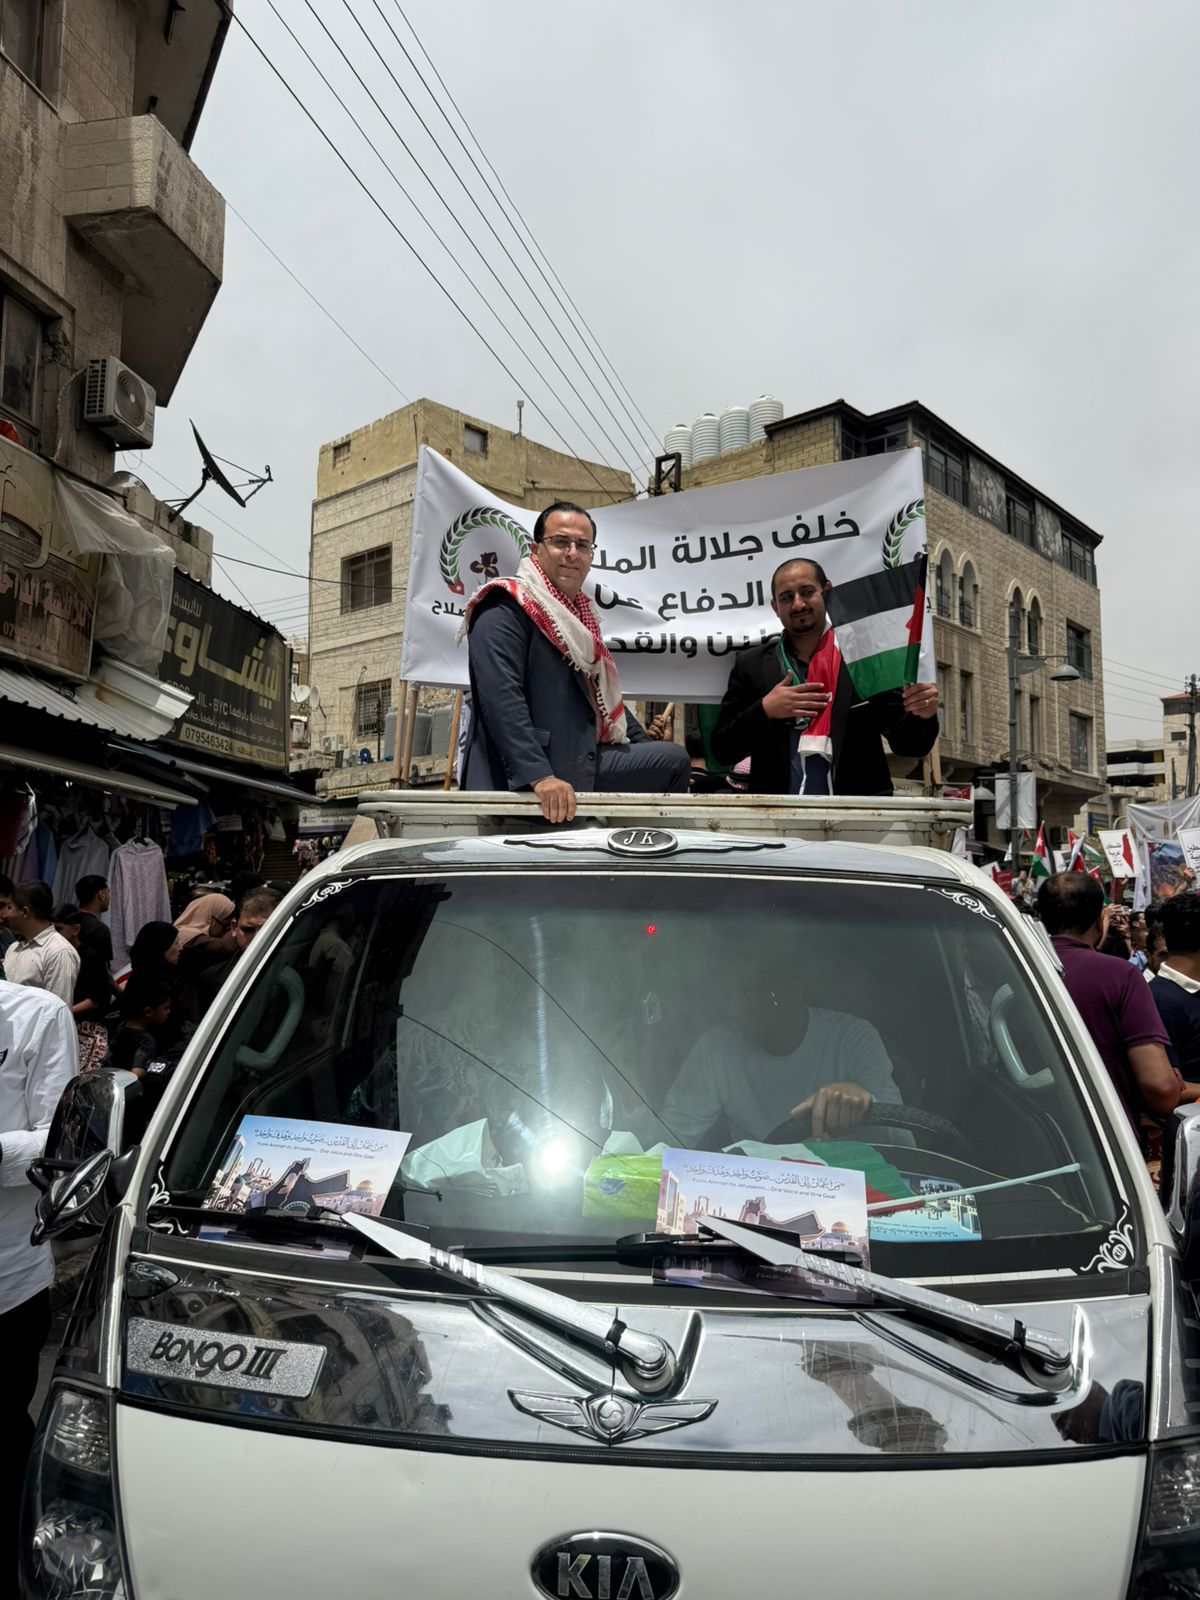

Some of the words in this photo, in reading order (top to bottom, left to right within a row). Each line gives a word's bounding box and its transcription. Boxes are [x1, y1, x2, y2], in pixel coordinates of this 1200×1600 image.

[772, 511, 860, 549] خلف
[672, 532, 763, 564] جلالة
[432, 601, 466, 617] صلاح
[594, 583, 644, 610] عن
[658, 580, 765, 622] الدفاع
[604, 632, 698, 659] والقد
[213, 698, 228, 716] BYC
[707, 1179, 730, 1187] Amman
[810, 1190, 822, 1198] One
[241, 1345, 288, 1380] III
[557, 1552, 656, 1600] KIA
